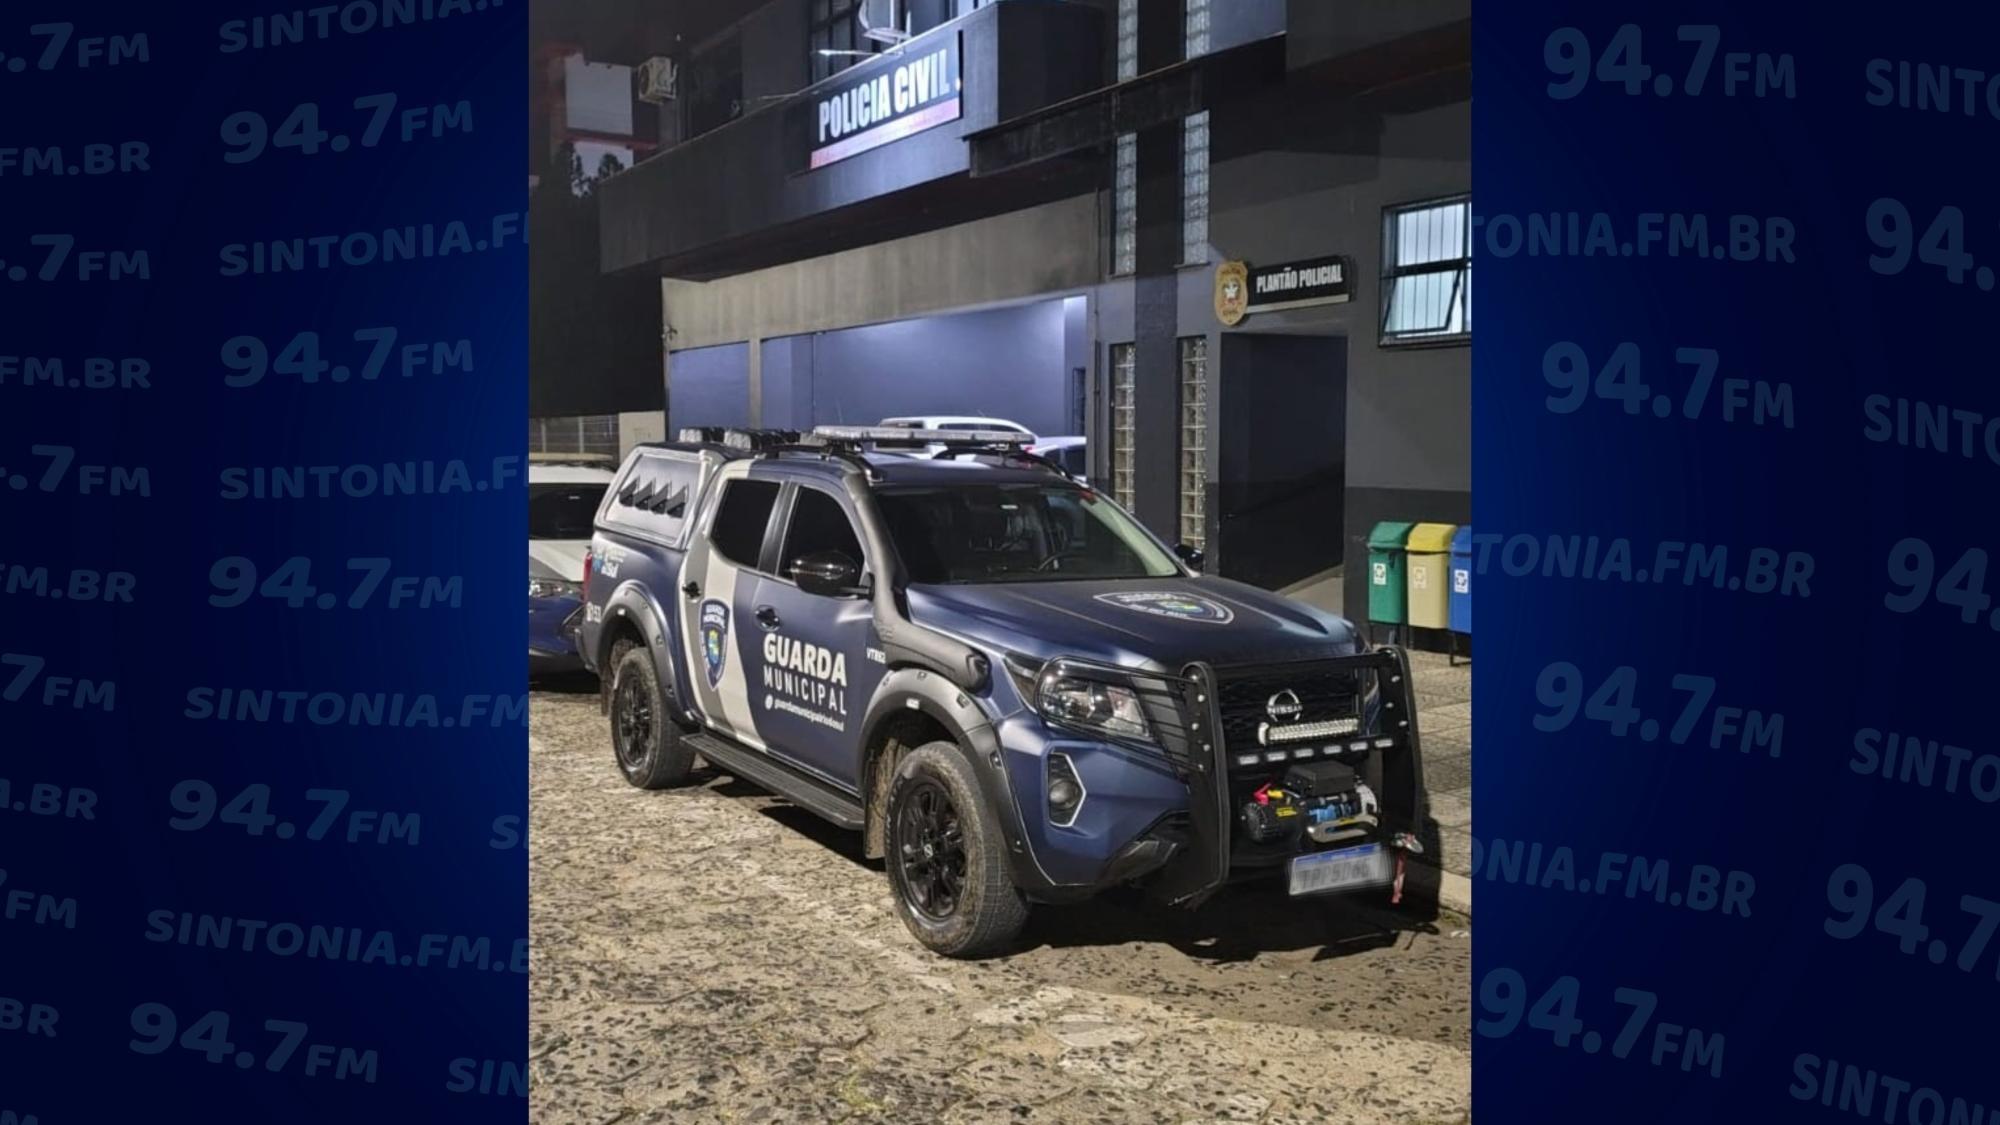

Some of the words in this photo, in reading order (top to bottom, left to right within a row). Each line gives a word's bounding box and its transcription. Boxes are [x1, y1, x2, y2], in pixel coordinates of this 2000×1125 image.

[818, 74, 892, 143] POLICIA
[894, 49, 950, 114] CIVIL
[1256, 266, 1298, 294] PLANTÃO
[1299, 264, 1343, 288] POLICIAL
[763, 632, 848, 687] GUARDA
[763, 665, 848, 715] MUNICIPAL
[1266, 703, 1304, 715] NISSAN
